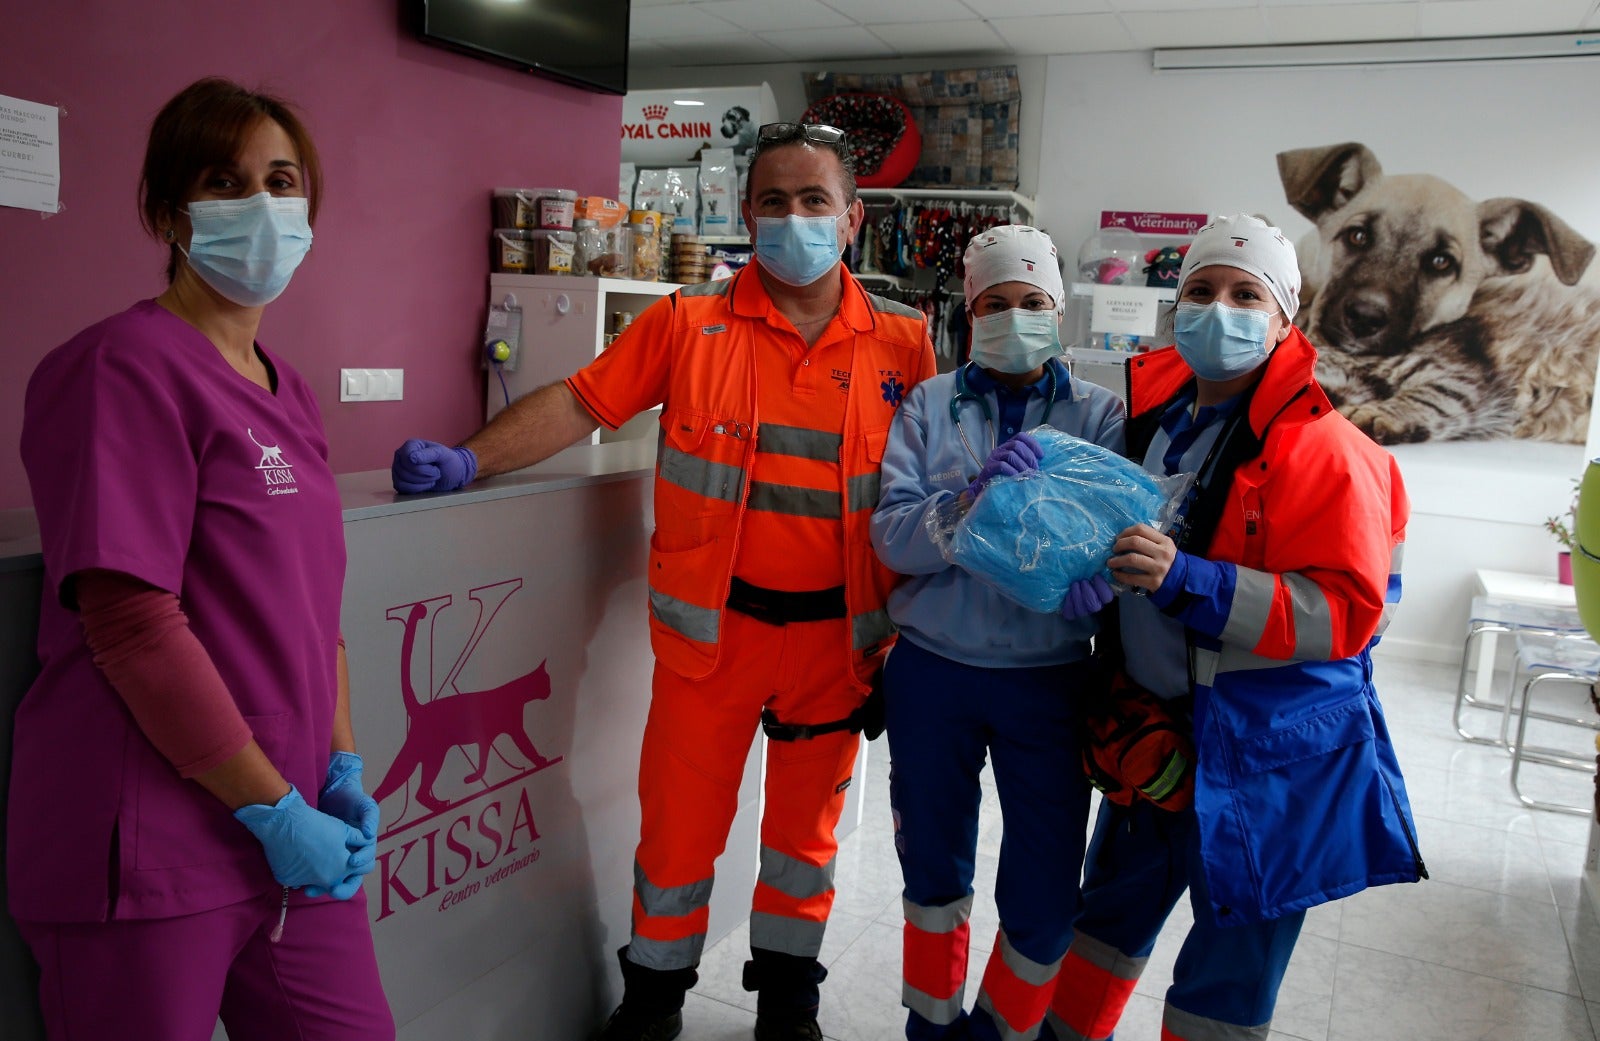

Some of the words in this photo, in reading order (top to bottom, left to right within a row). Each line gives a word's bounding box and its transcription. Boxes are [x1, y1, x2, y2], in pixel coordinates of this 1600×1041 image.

[657, 122, 712, 139] CANIN
[1132, 215, 1198, 229] Veterinario
[263, 468, 296, 485] KISSA
[374, 786, 542, 923] KISSA
[438, 881, 481, 912] Centro
[484, 847, 540, 888] veterinario
